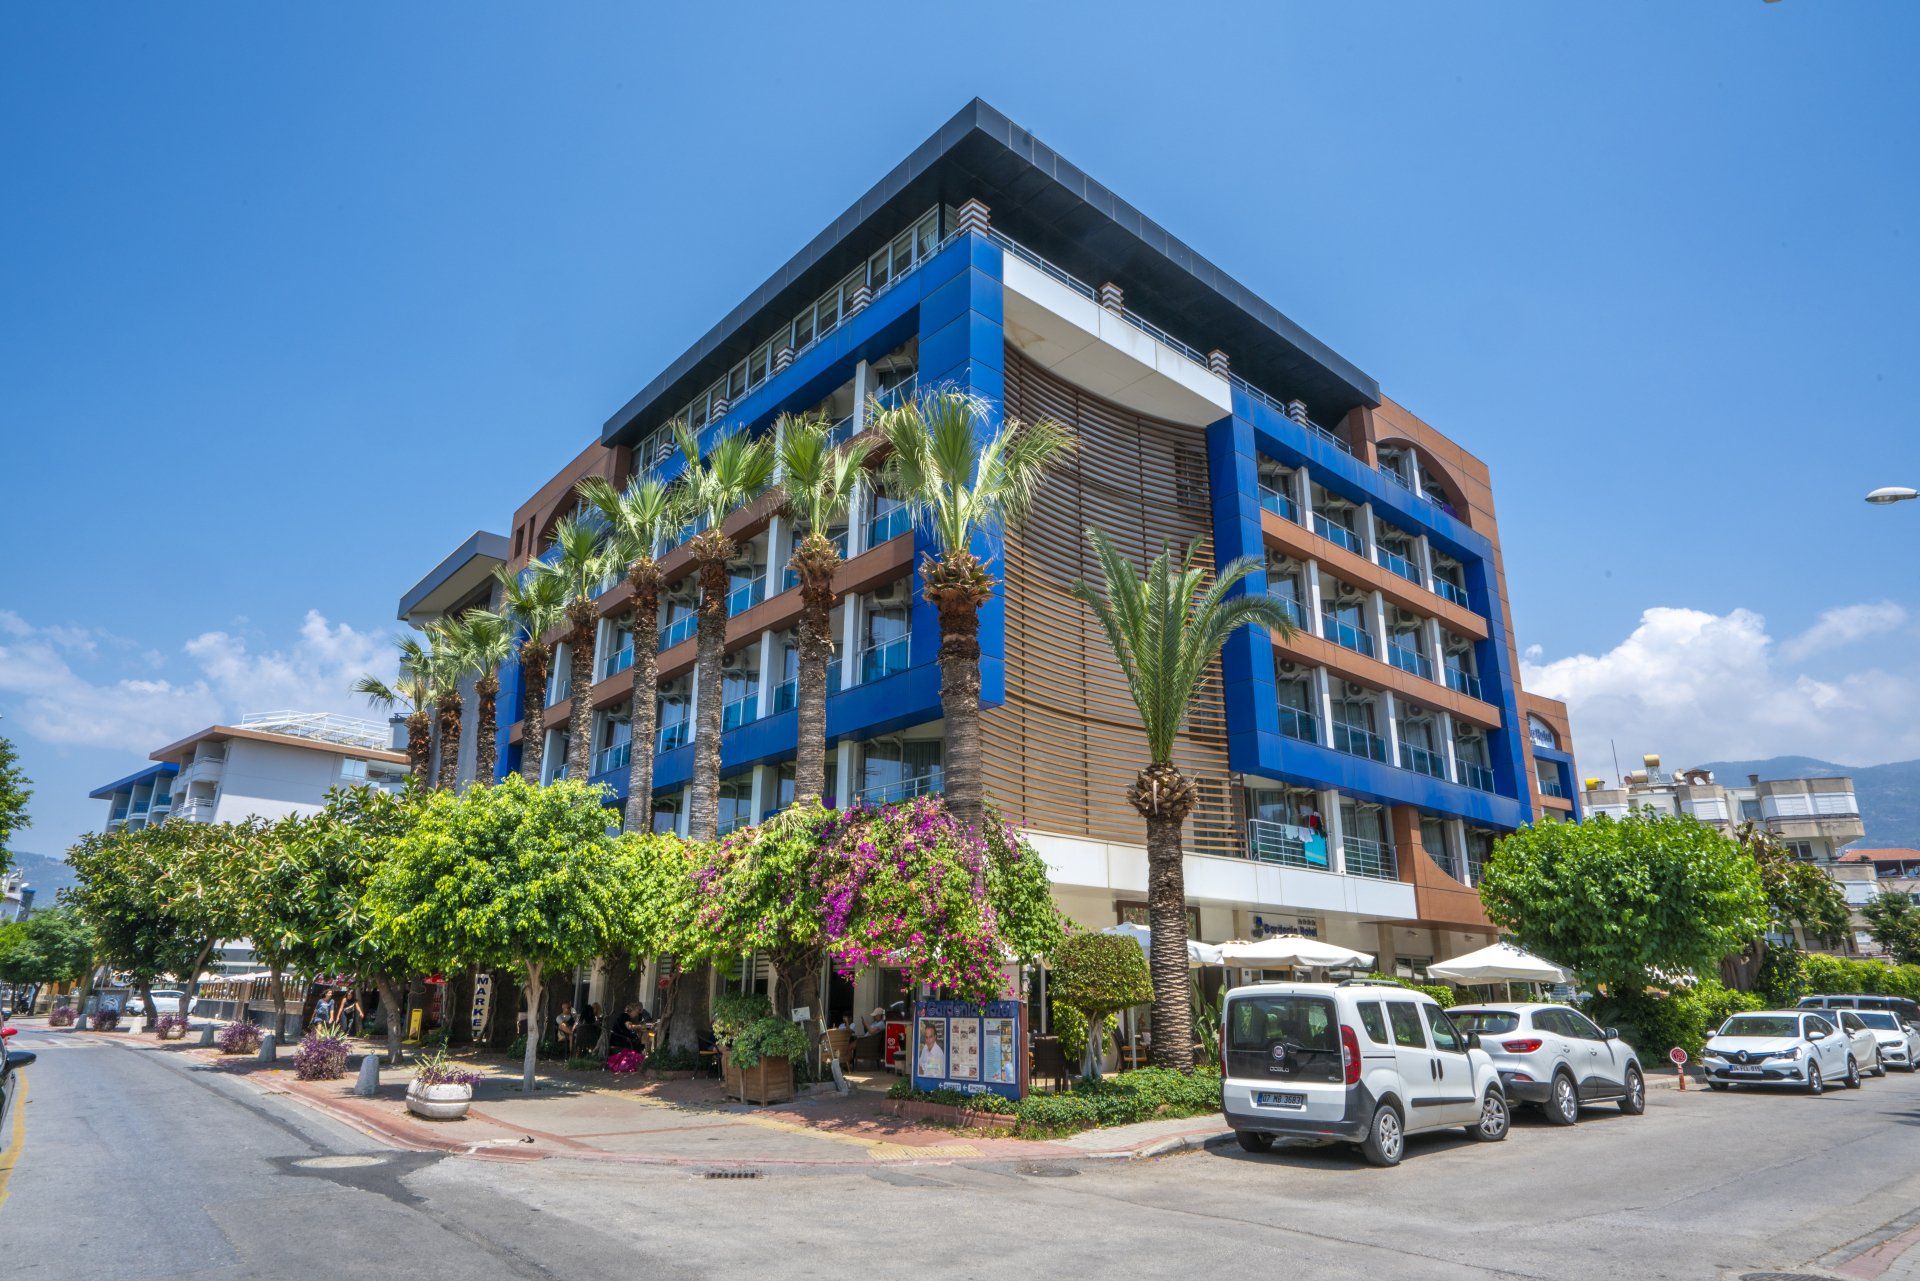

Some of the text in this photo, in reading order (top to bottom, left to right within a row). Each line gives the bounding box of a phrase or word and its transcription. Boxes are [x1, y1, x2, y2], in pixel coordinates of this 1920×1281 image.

[1299, 926, 1317, 936] Hotel
[472, 977, 489, 1037] MARKET
[1262, 1094, 1271, 1102] 07
